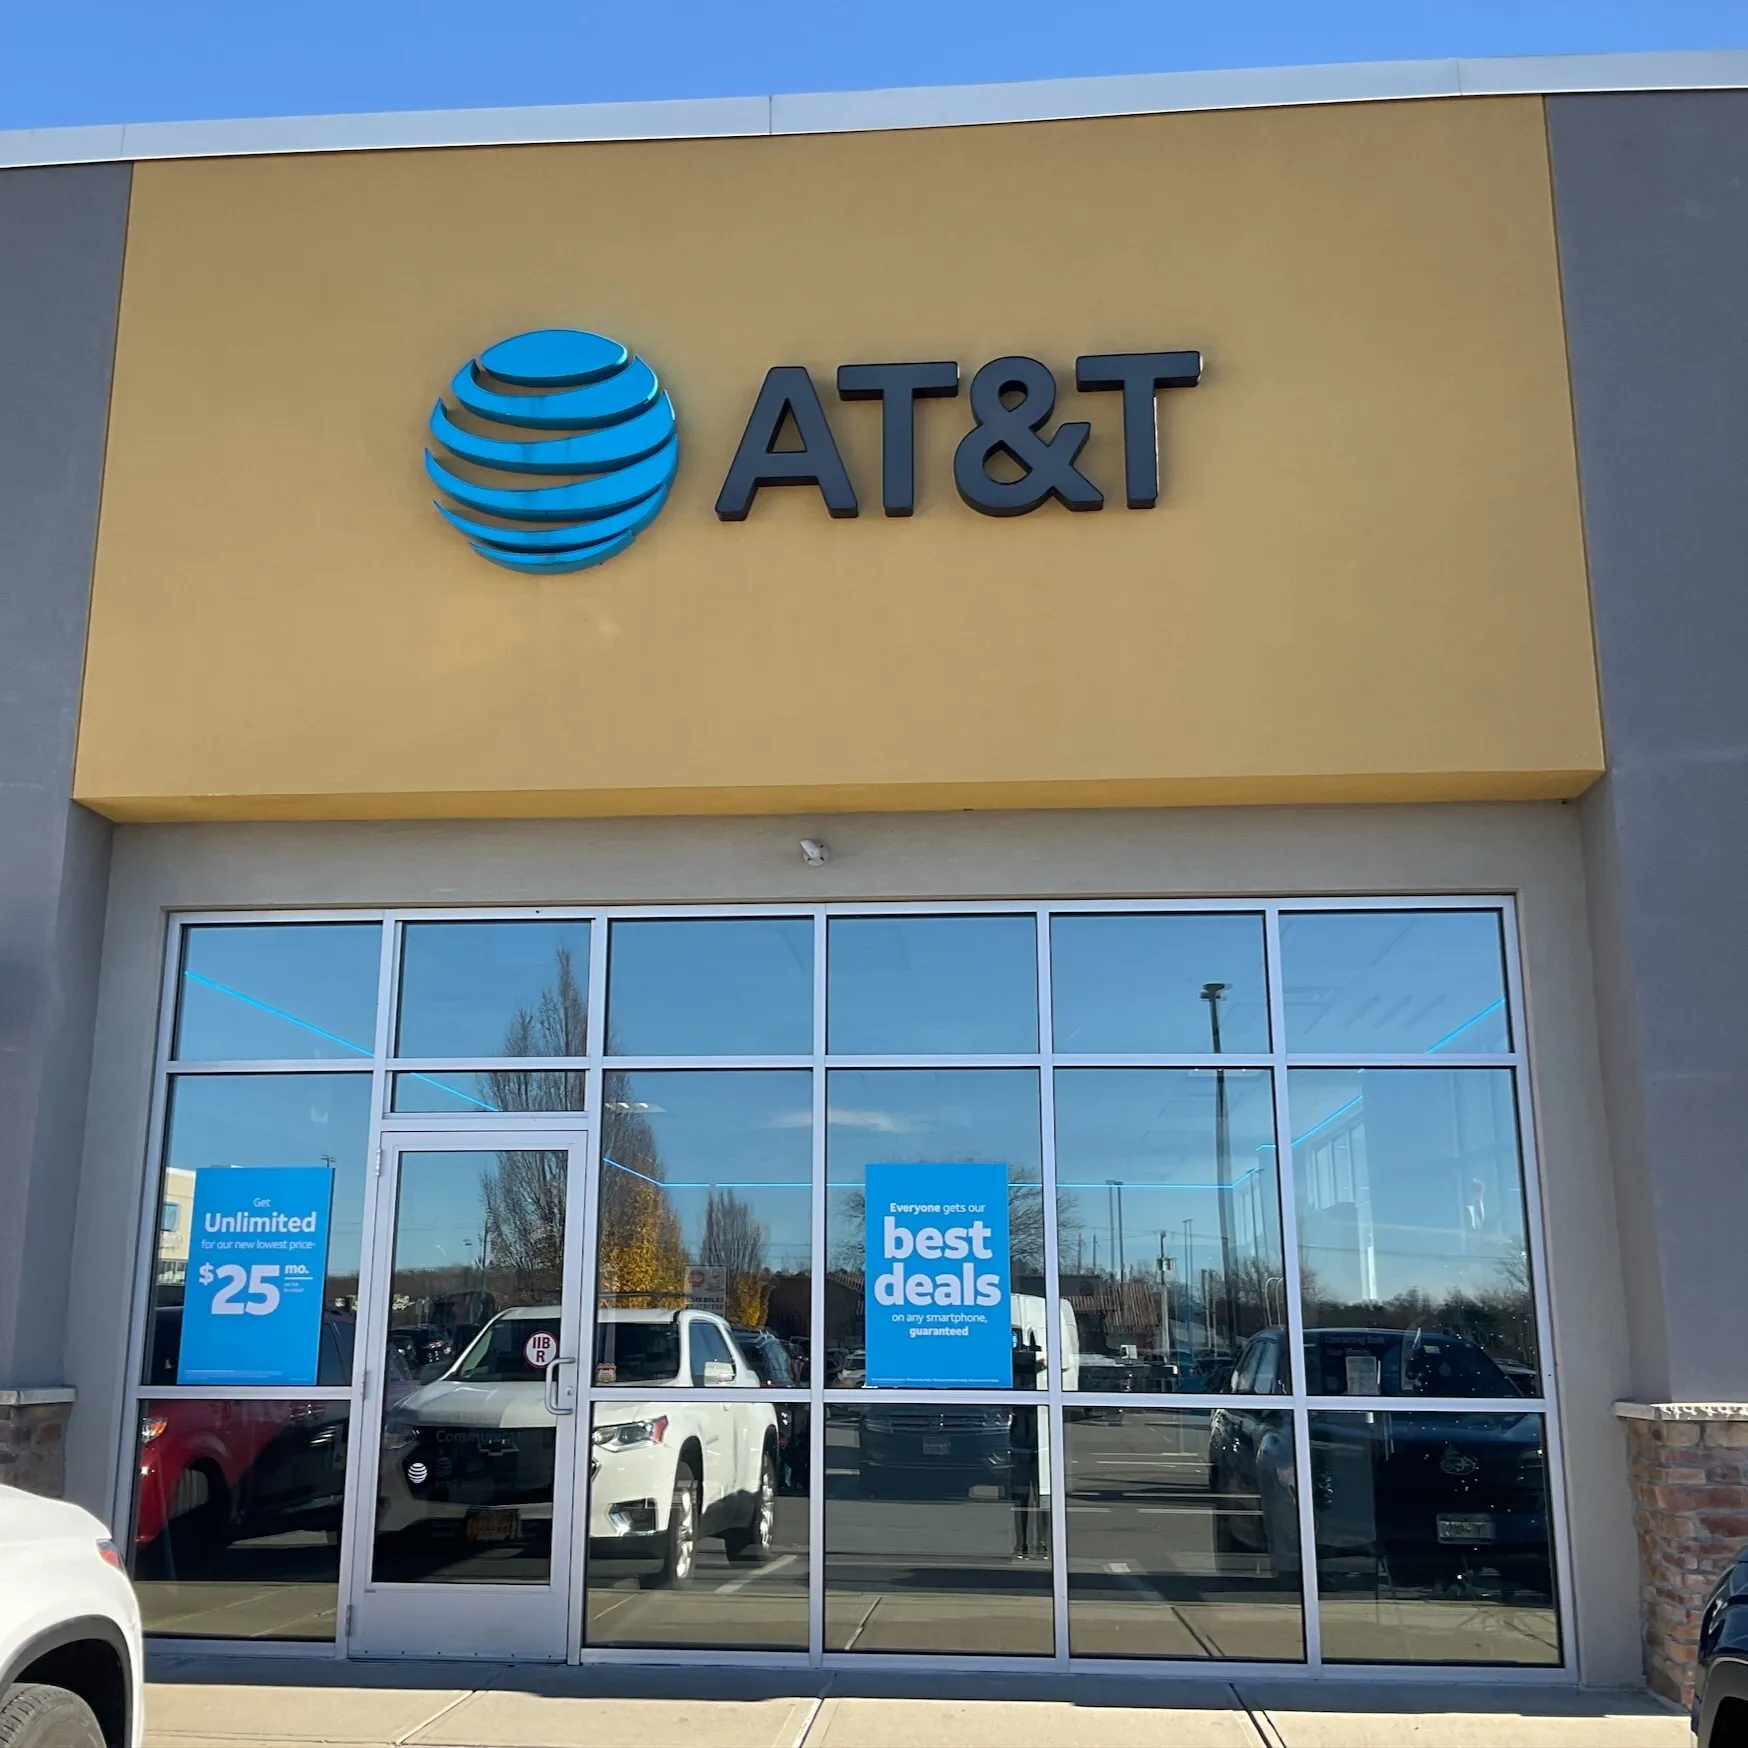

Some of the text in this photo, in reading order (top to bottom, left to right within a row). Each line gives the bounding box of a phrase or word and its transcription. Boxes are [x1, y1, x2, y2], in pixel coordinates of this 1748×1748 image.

[715, 351, 1203, 521] AT&T
[253, 1197, 271, 1208] Get
[889, 1203, 986, 1215] Everyone gets our
[204, 1211, 317, 1233] Unlimited
[884, 1216, 993, 1259] best
[201, 1239, 215, 1249] for
[217, 1241, 233, 1249] our
[234, 1241, 254, 1249] new
[256, 1239, 287, 1249] lowest
[284, 1264, 309, 1275] mo.
[874, 1262, 1002, 1306] deals
[892, 1313, 988, 1325] on any smartphone,
[909, 1326, 969, 1338] guaranteed
[536, 1350, 546, 1363] R
